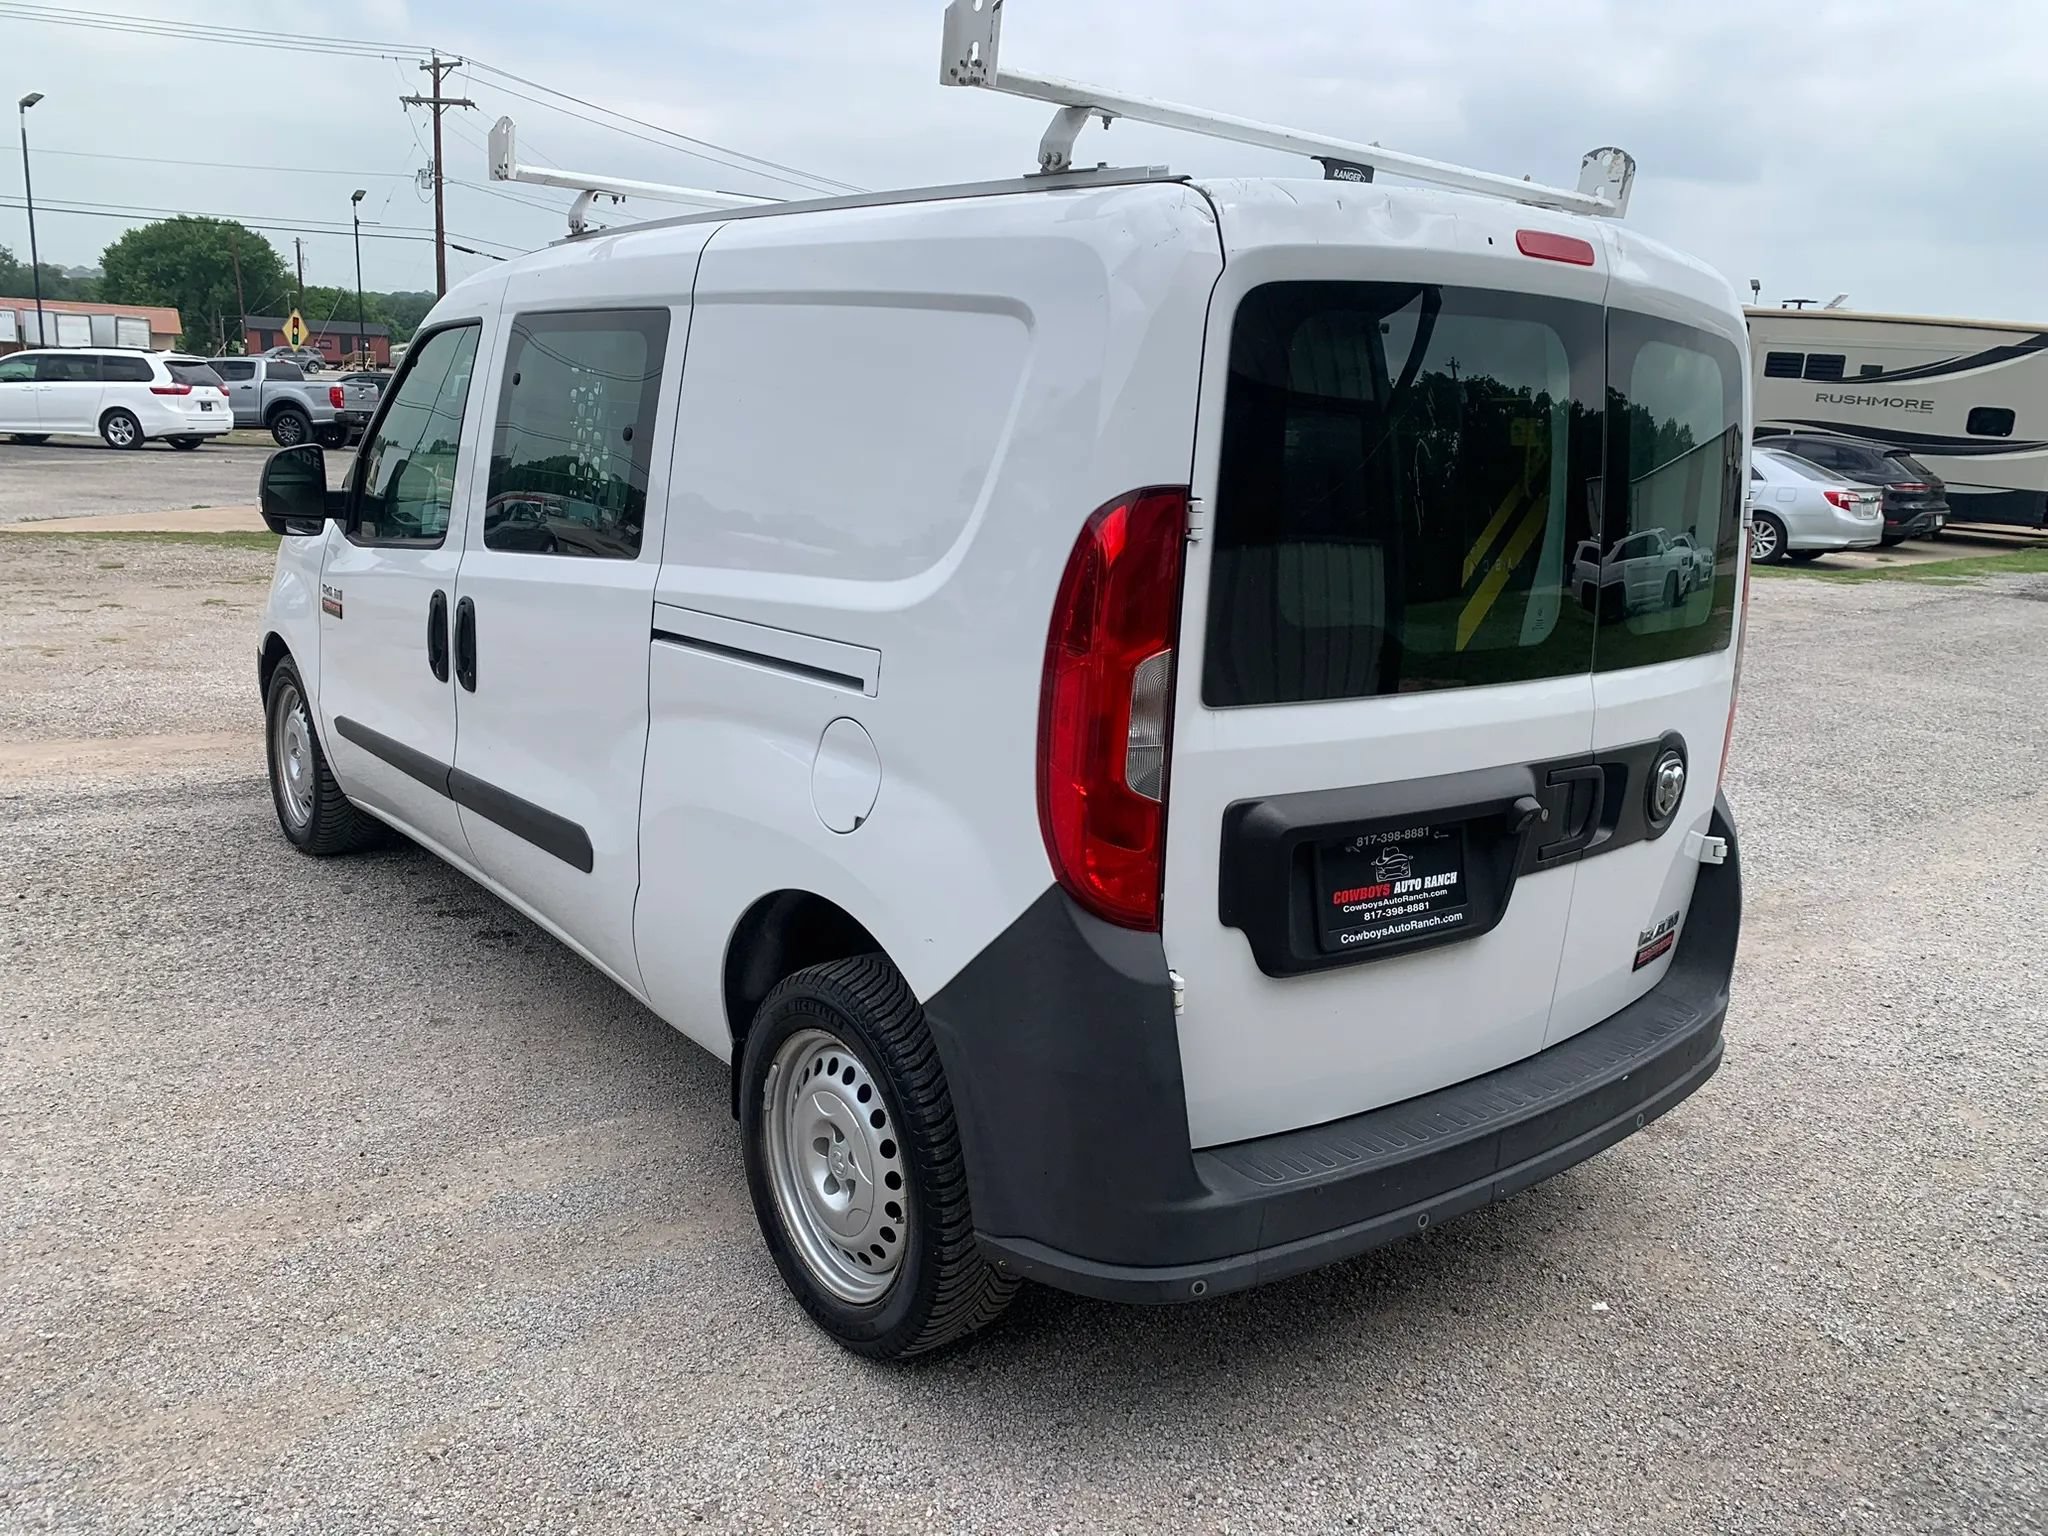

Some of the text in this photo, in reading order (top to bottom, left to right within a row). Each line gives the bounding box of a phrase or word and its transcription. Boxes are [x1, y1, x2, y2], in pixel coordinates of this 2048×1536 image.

[1333, 168, 1362, 182] RANGER
[1815, 392, 1935, 411] RUSHMORE
[1356, 826, 1430, 847] 817-398-8881
[1333, 871, 1458, 905] COWBOYS AUTO RANCH
[1342, 888, 1448, 913] CowboysAutoRanch.com
[1363, 902, 1430, 921] 817-398-8881
[1340, 912, 1463, 944] CowboysAutoRanch.com
